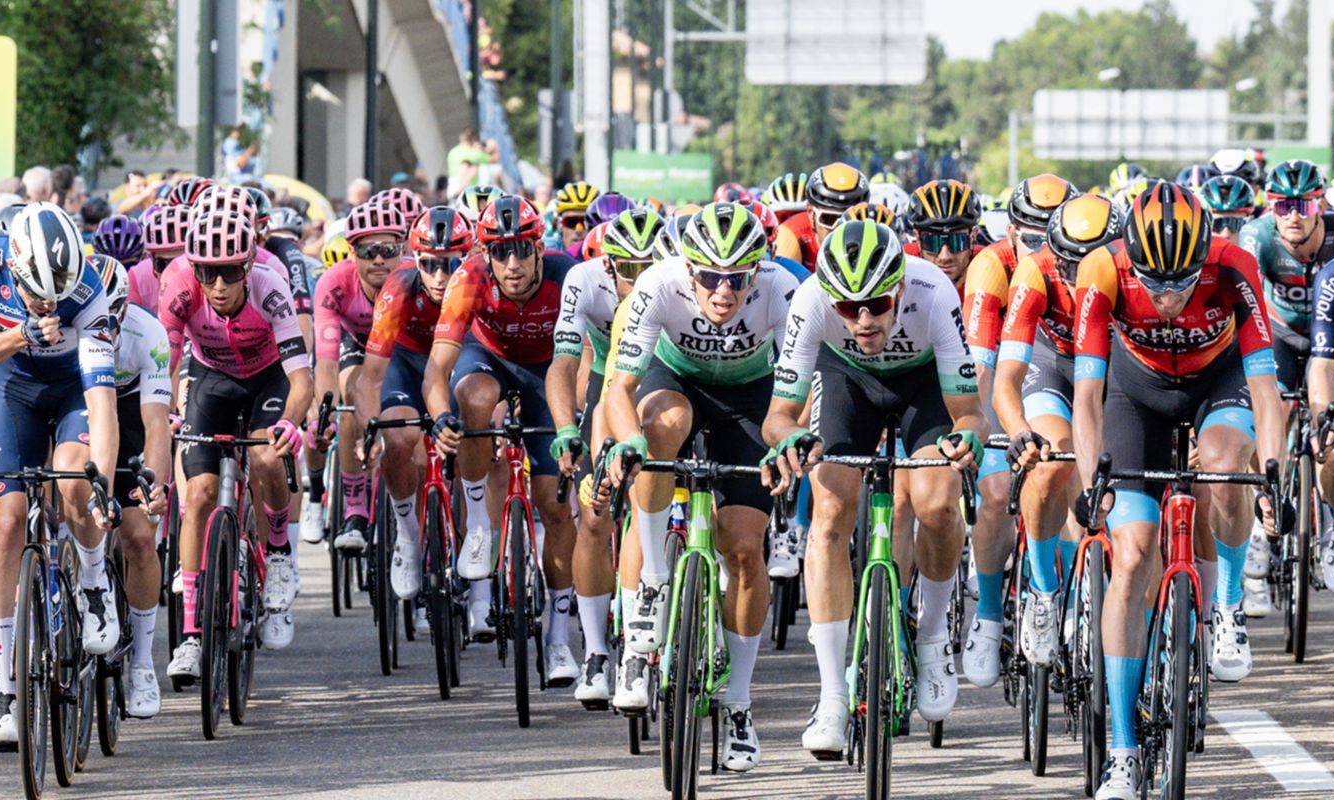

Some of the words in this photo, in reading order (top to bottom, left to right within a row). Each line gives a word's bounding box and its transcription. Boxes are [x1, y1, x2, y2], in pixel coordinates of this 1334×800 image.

[562, 284, 582, 324] ALEA
[627, 290, 653, 336] ALEA
[968, 286, 986, 340] MERIDA
[1003, 281, 1031, 335] MERIDA
[1075, 282, 1099, 350] MERIDA
[1114, 315, 1232, 338] BAHRAIN
[1235, 281, 1271, 343] MERIDA
[678, 333, 759, 354] RURAL
[783, 313, 806, 359] ALEA
